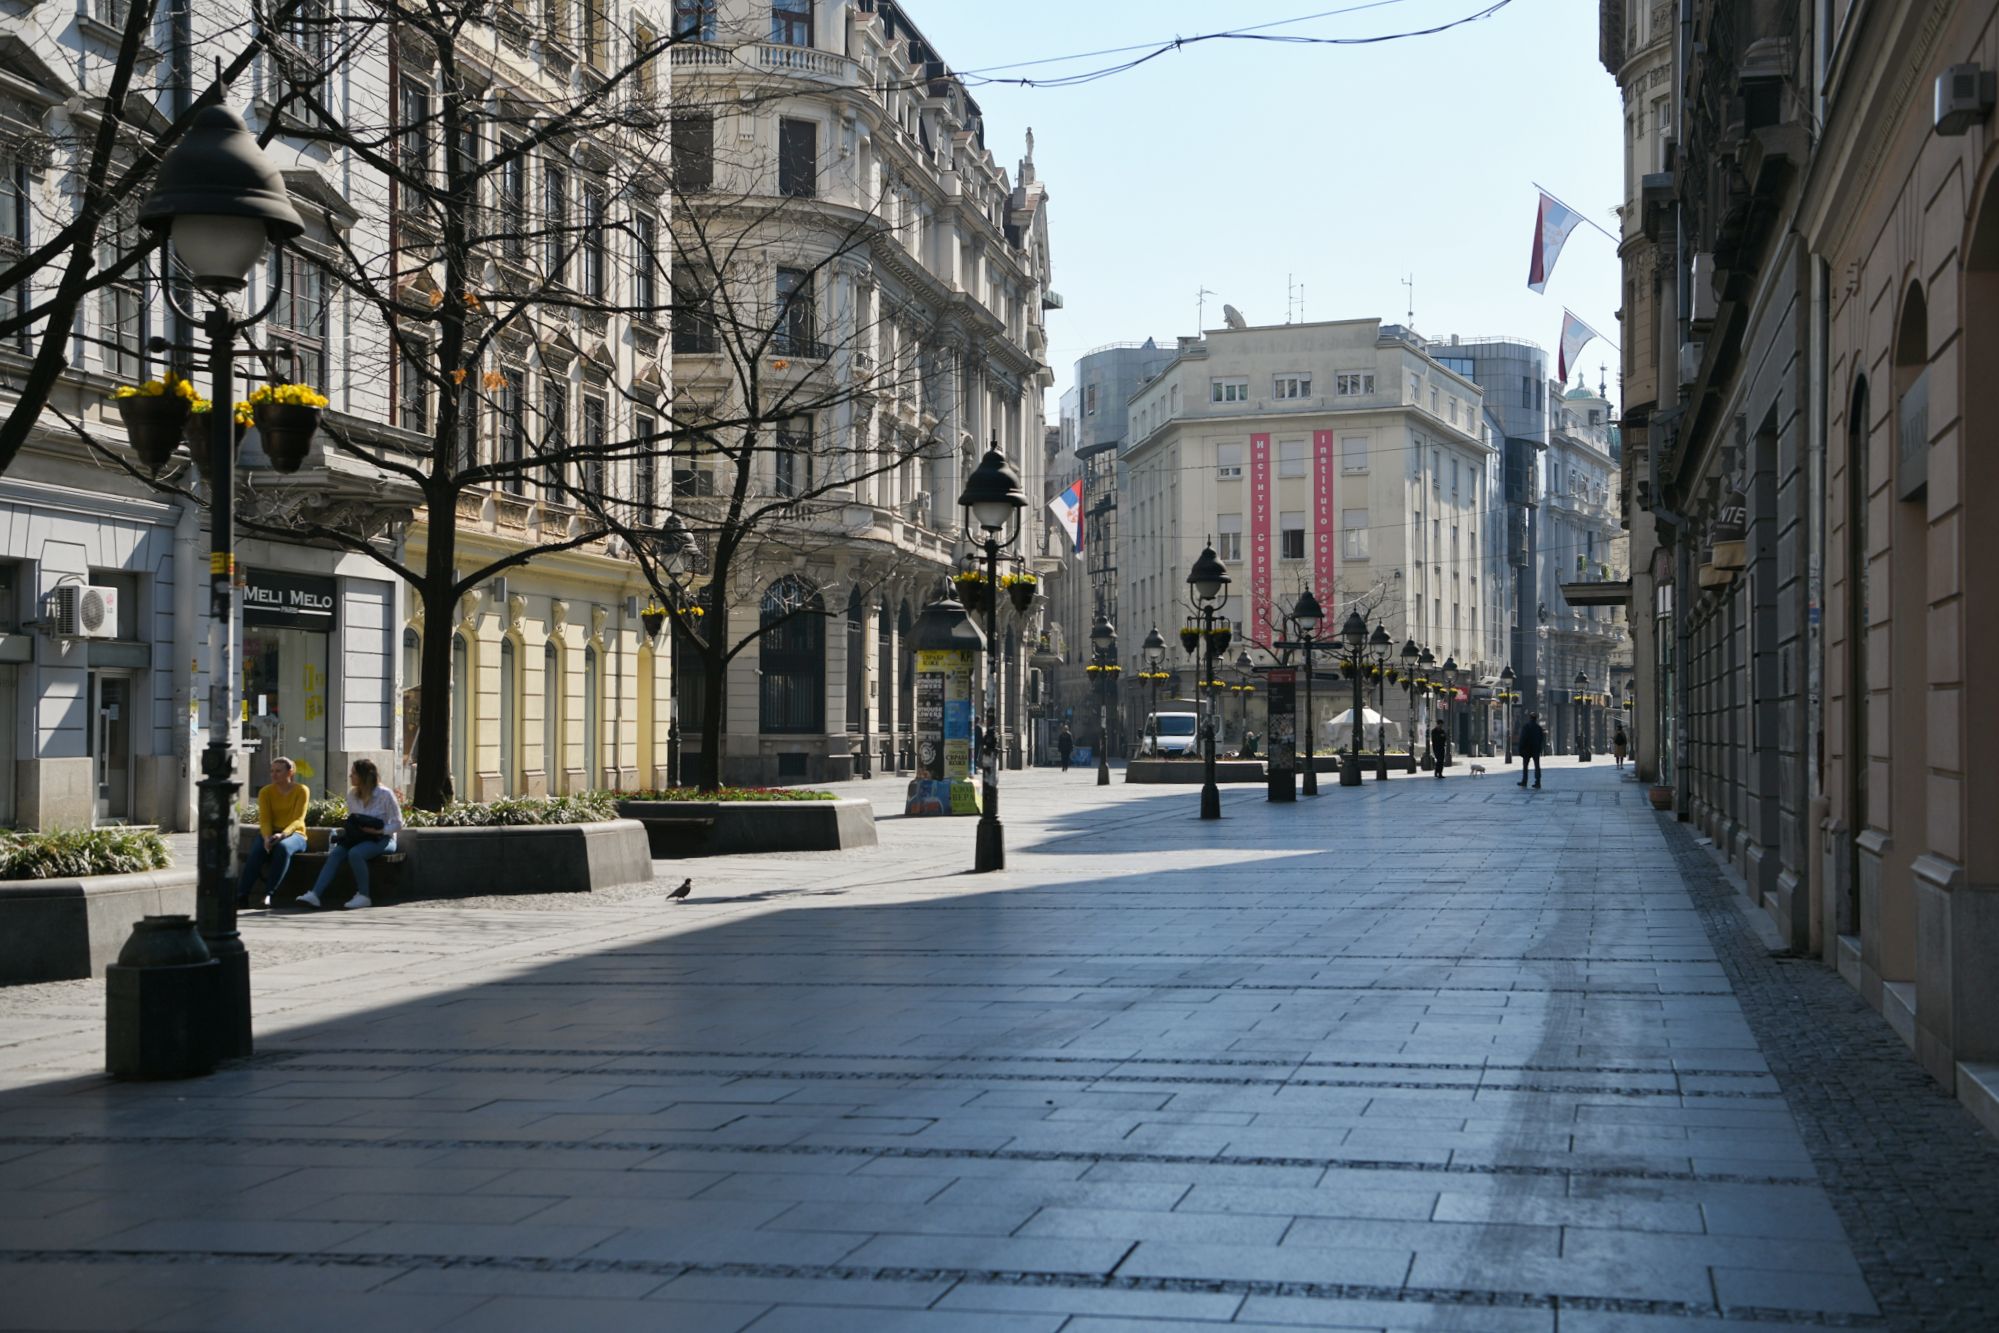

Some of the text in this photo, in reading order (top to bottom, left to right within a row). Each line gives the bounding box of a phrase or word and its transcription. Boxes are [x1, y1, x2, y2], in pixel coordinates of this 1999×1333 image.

[1256, 440, 1265, 522] Институт
[1320, 434, 1328, 525] Instituto
[243, 586, 333, 609] MELI MELO
